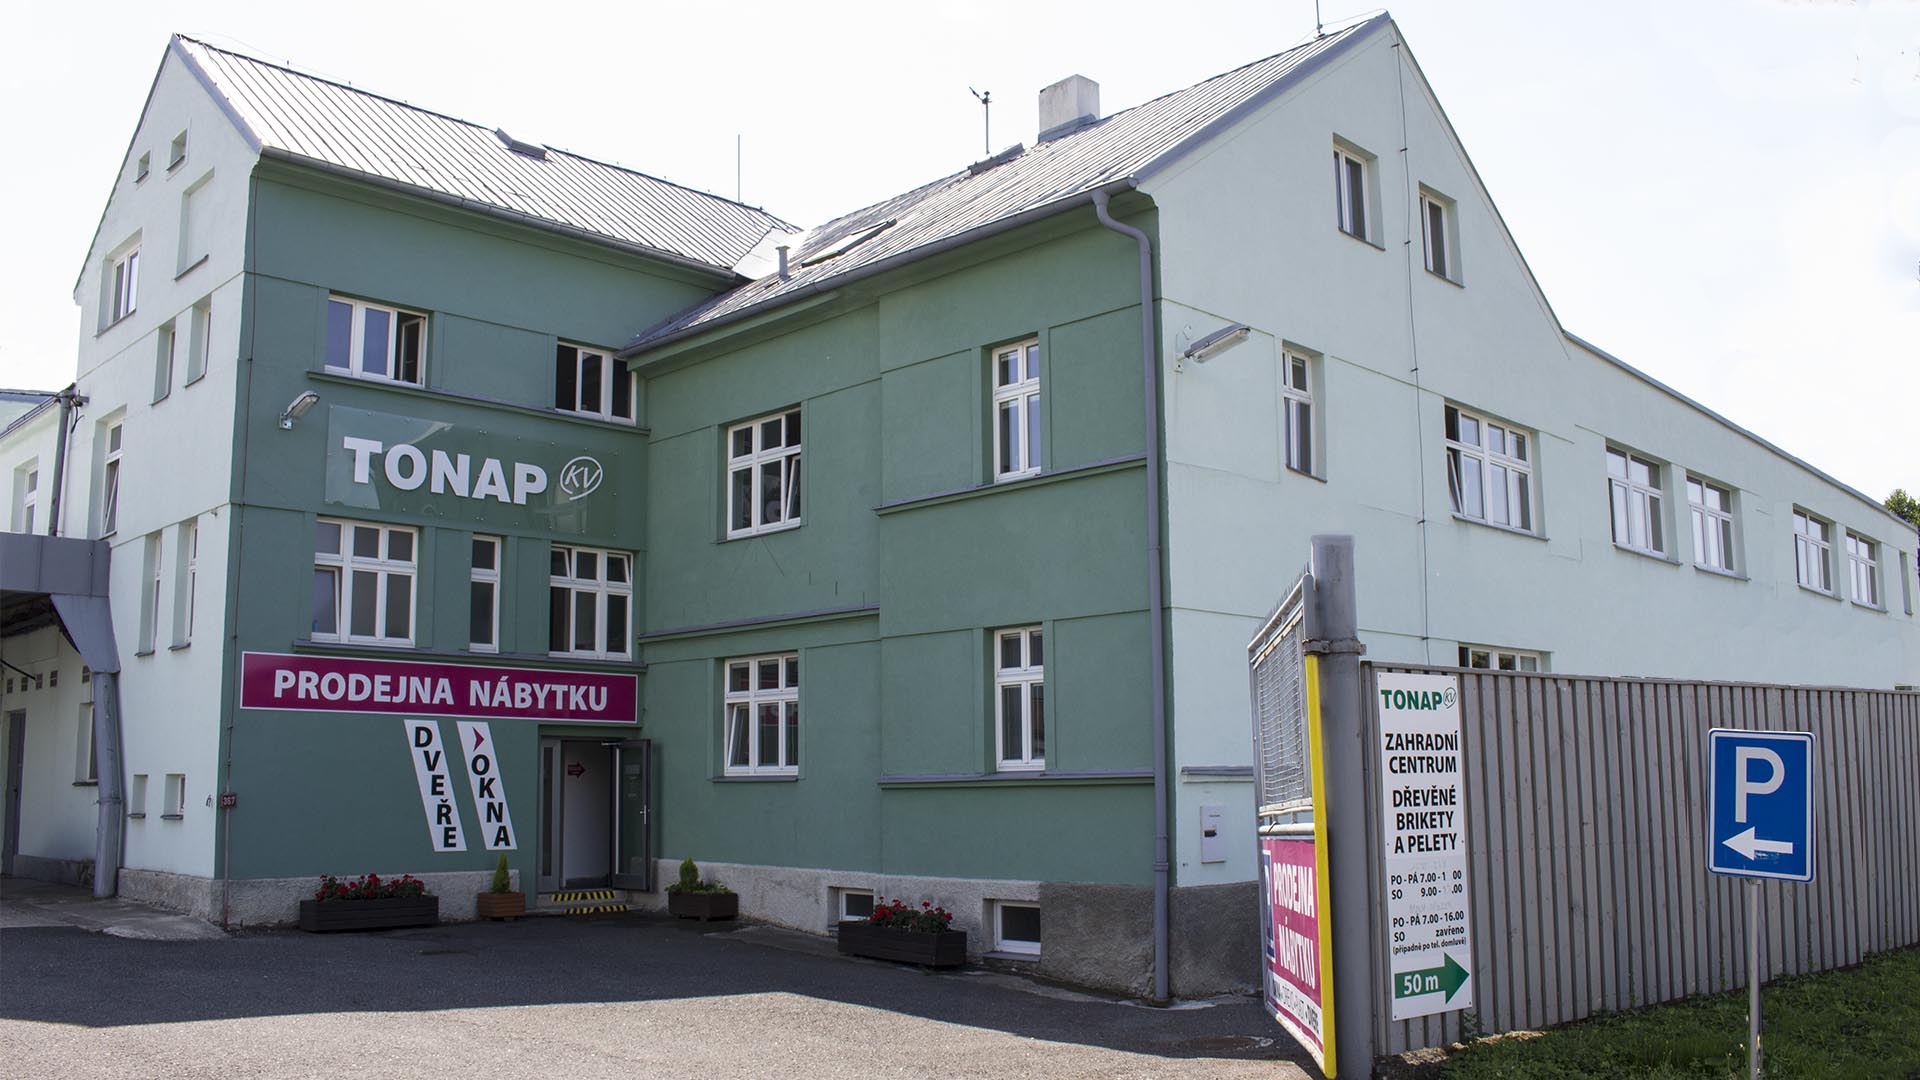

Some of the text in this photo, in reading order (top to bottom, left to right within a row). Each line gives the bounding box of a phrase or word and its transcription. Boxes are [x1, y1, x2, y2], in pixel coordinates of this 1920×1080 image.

[343, 436, 547, 505] TONAP
[273, 669, 608, 712] PRODEJNA NÁBYTKU
[1380, 689, 1443, 711] TONAP
[1385, 730, 1458, 751] ZAHRADNÍ
[1389, 756, 1457, 774] CENTRUM
[414, 726, 457, 848] DVEŘE
[1735, 746, 1785, 823] P
[471, 753, 511, 847] OKNA
[1392, 785, 1457, 808] DŘEVĚNÉ
[1396, 811, 1454, 831] BRIKETY
[1394, 833, 1458, 854] A PELETY
[1391, 875, 1402, 886] PO
[1408, 871, 1418, 884] PÁ
[1420, 873, 1436, 883] 7.00
[1273, 862, 1315, 918] PRODEJNA
[1391, 889, 1403, 900] SO
[1421, 886, 1437, 897] 9.00
[1393, 917, 1405, 928] PO
[1411, 914, 1421, 926] PÁ
[1422, 914, 1438, 925] 7.00
[1444, 910, 1464, 922] 16.00
[1394, 925, 1465, 943] SO zavřeno
[1278, 916, 1316, 989] NÁBYTKU
[1422, 944, 1430, 953] po
[1403, 973, 1439, 995] 50 m
